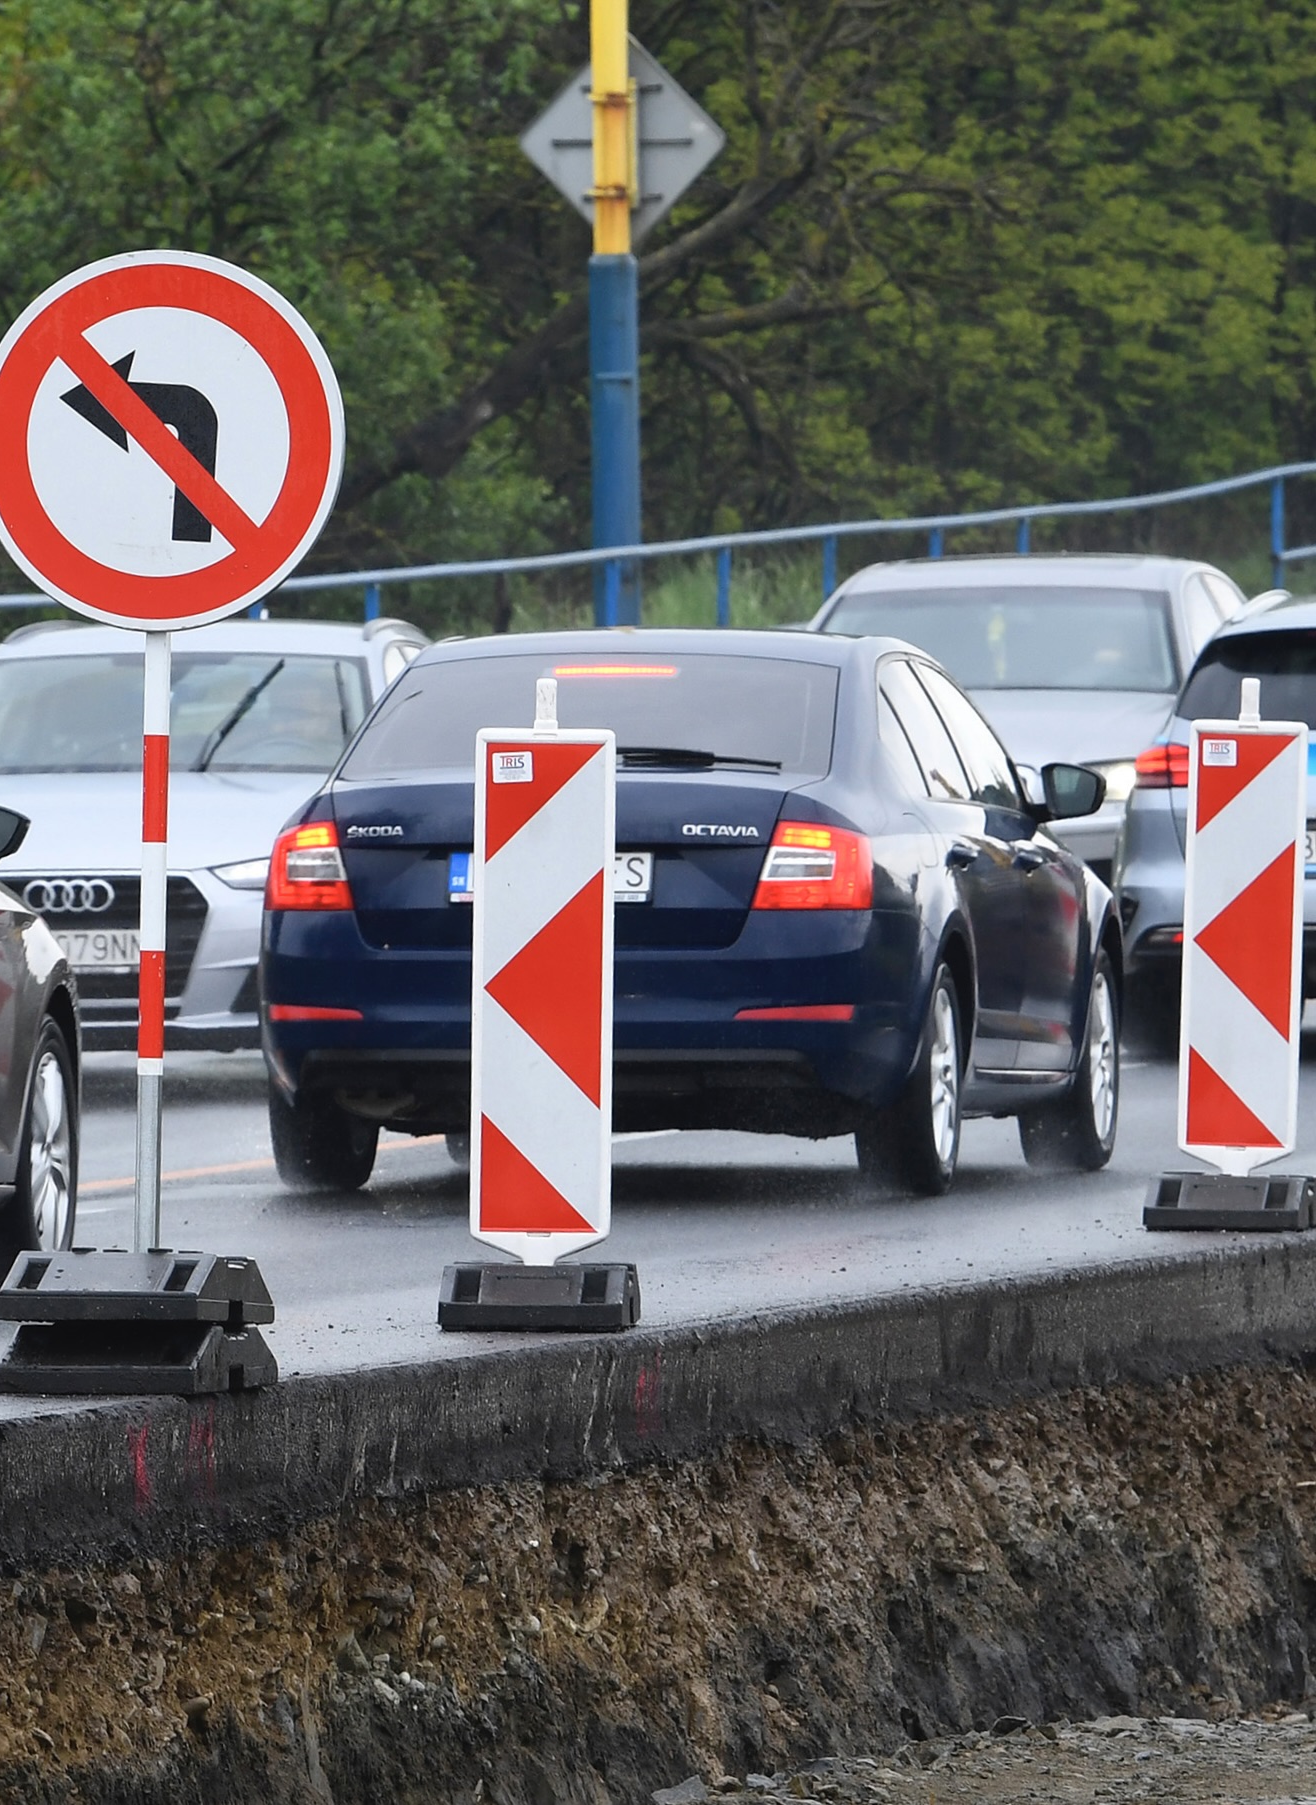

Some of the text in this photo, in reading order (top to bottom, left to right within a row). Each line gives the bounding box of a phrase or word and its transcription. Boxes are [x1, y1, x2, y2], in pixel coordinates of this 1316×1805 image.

[499, 754, 525, 770] TRIS
[346, 825, 404, 839] ŠKODA
[682, 823, 759, 838] OCTAVIA
